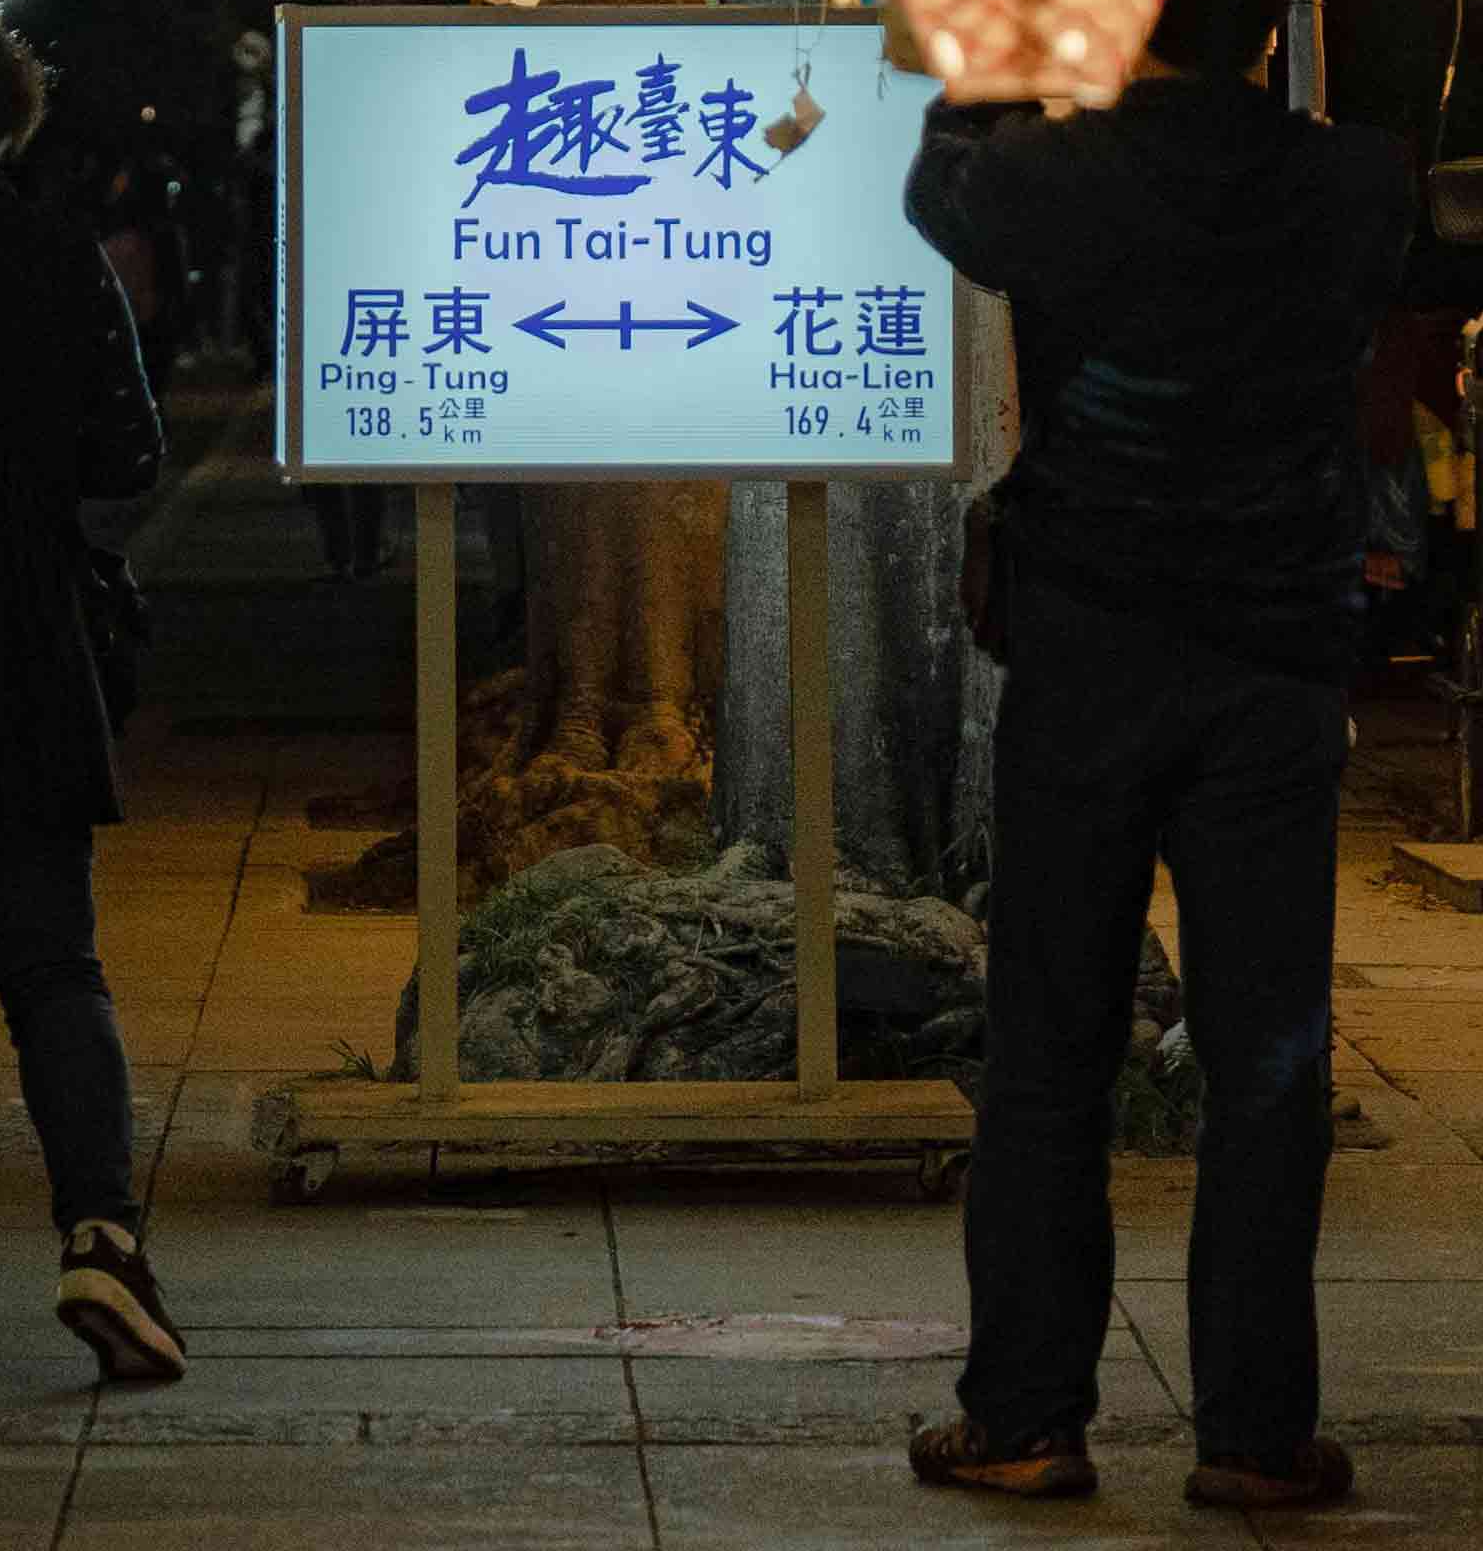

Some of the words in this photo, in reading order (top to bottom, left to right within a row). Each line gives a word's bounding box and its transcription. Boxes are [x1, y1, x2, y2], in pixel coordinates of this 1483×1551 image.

[454, 47, 771, 209] 趣臺東
[453, 217, 541, 261] Fun
[555, 217, 773, 267] Tai-Tung
[339, 285, 493, 359] 屏東
[772, 284, 928, 358] 花蓮
[769, 361, 935, 393] Hua-Lien
[438, 397, 487, 420] 公里
[877, 396, 927, 419] 公里
